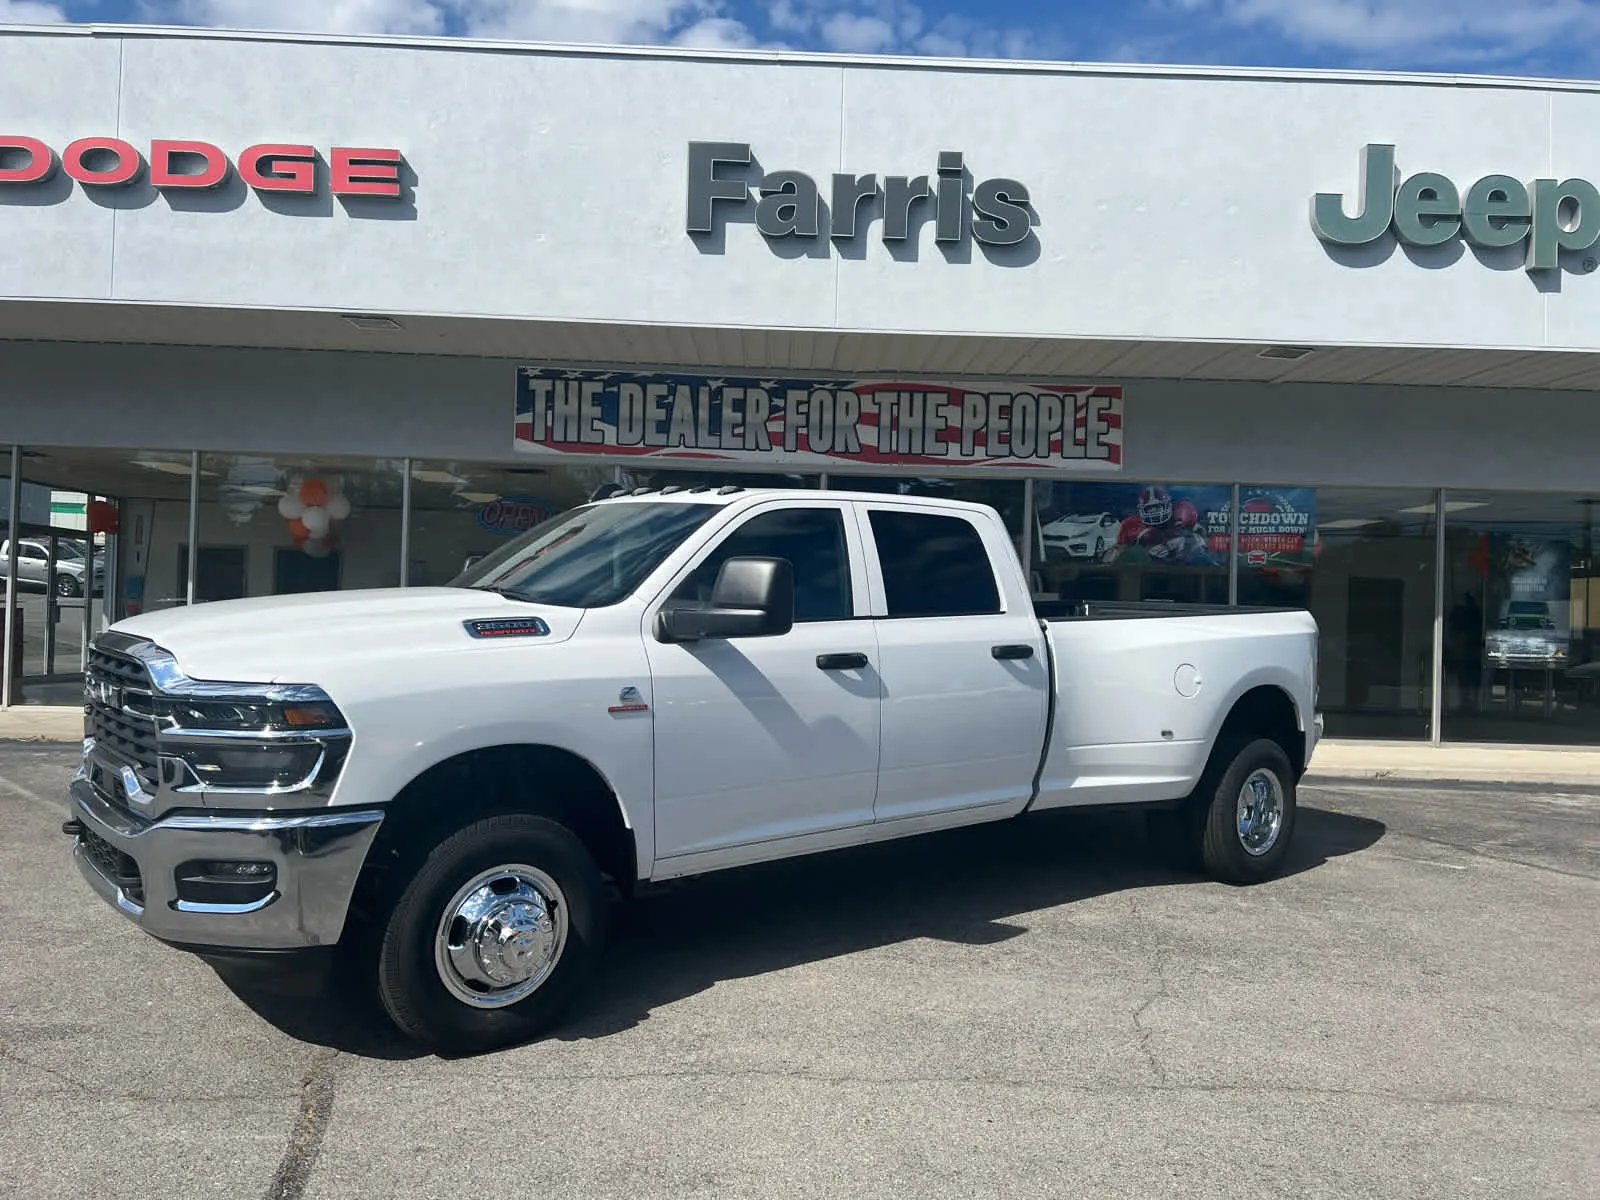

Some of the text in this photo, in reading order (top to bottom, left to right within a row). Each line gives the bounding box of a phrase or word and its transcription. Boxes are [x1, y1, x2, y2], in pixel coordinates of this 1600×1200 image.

[0, 135, 402, 197] DODGE
[687, 141, 1031, 245] Farris
[1309, 143, 1600, 270] Jeep
[528, 378, 1112, 459] THE DEALER FOR THE PEOPLE
[1207, 511, 1309, 525] TOCHDOWN
